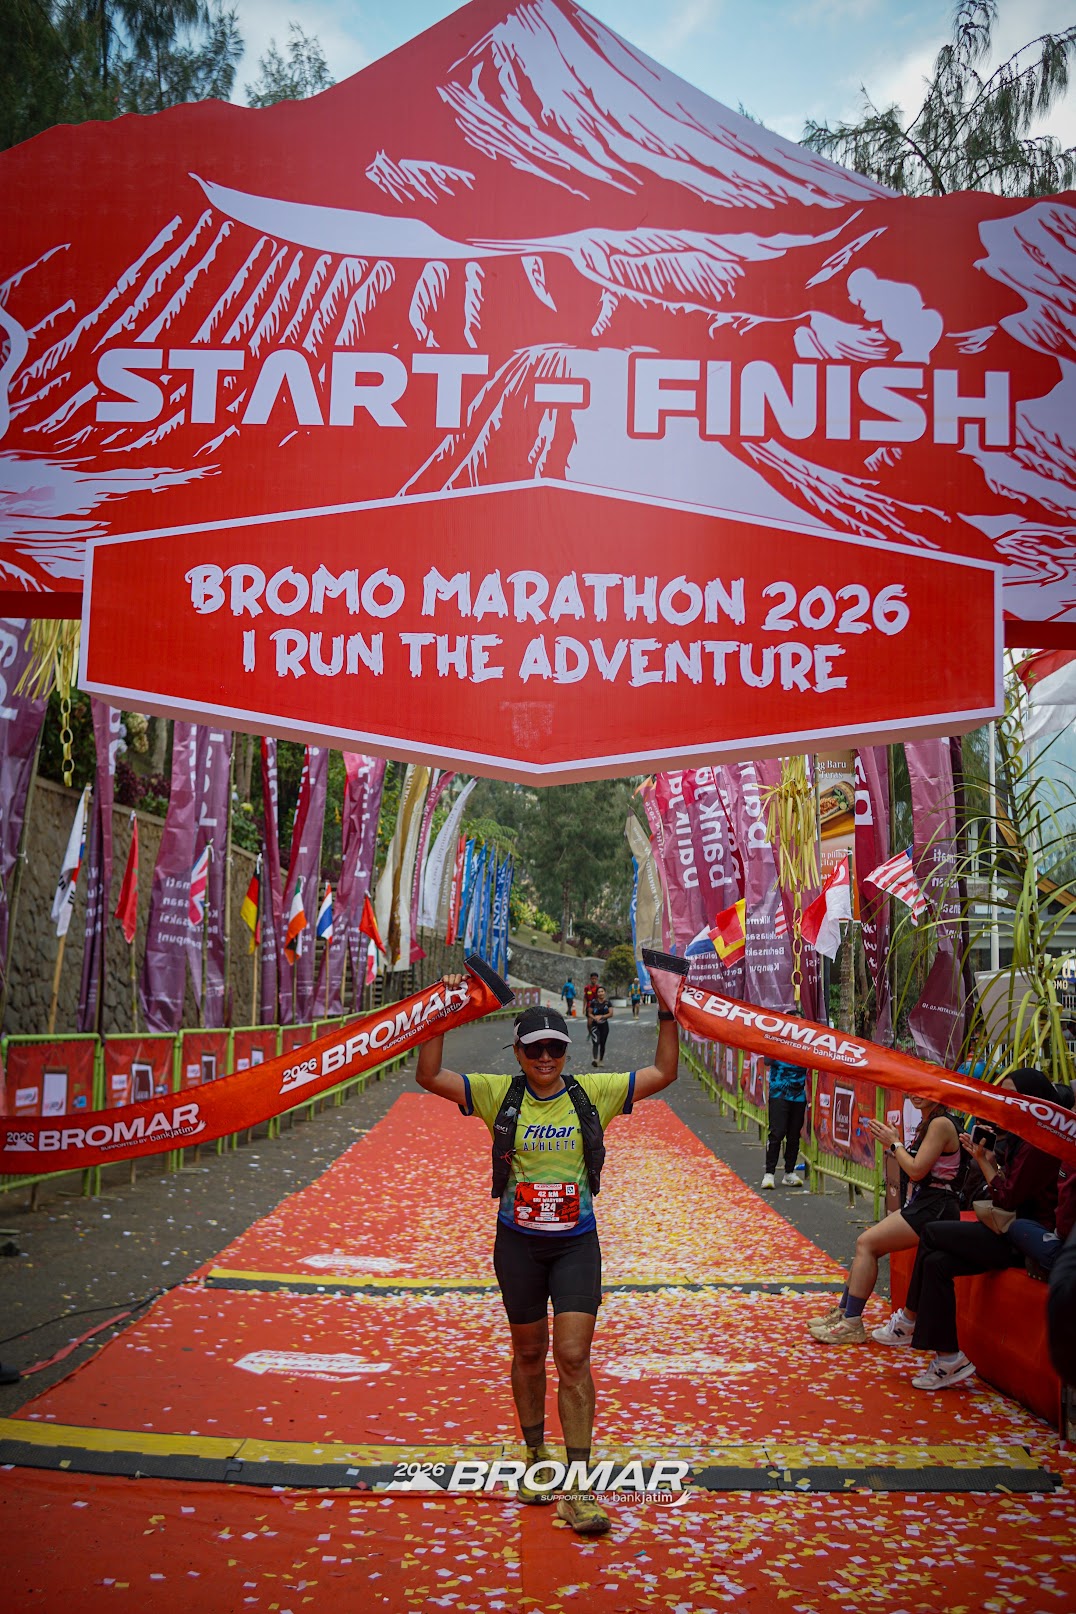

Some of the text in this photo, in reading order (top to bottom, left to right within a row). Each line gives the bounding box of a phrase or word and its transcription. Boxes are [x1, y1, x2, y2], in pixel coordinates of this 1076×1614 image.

[96, 348, 489, 428] START
[634, 358, 1010, 446] FINISH
[184, 563, 910, 636] BROMO MARATHON 2026
[243, 628, 848, 693] I RUN THE ADVENTURE
[827, 760, 847, 769] Baru
[283, 980, 470, 1083] 2026 BROMAR
[383, 1028, 416, 1051] SUPPORTED
[416, 1024, 425, 1032] BY
[702, 995, 867, 1058] BROMAR
[764, 1034, 801, 1050] SUPPORTED
[813, 1046, 856, 1063] bankjatim
[6, 1103, 200, 1151] 2026 BROMAR
[101, 1140, 138, 1151] SUPPORTED
[150, 1125, 194, 1142] bankjatim
[523, 1124, 574, 1139] Fitbar
[523, 1140, 576, 1151] ATHLETE
[540, 1203, 556, 1211] 124
